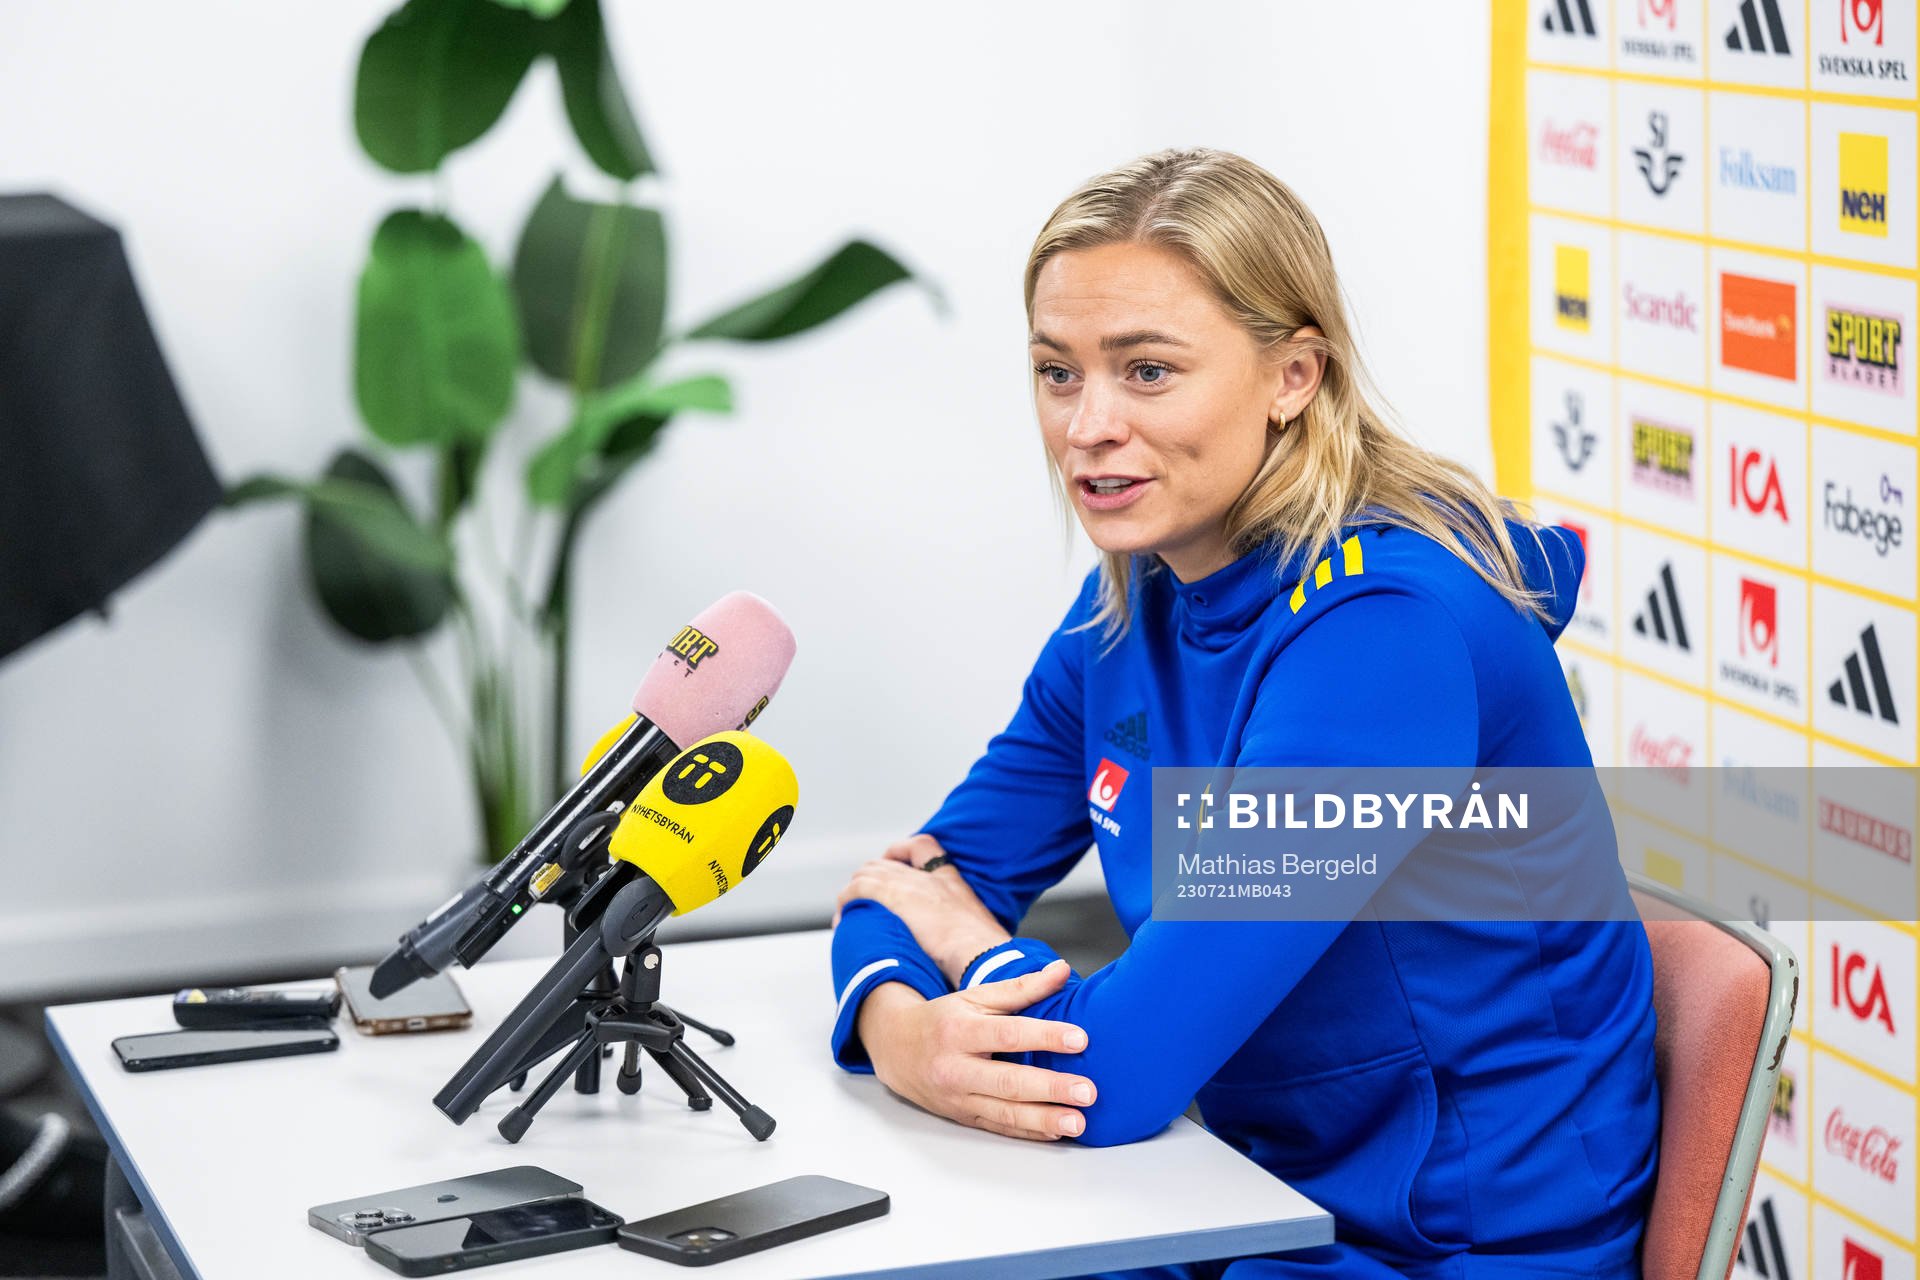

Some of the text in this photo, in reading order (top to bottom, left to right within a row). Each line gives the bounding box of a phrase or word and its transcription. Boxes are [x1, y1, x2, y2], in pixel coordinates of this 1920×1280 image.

[1818, 55, 1909, 81] SVENSKA SPEL
[1826, 308, 1901, 371] SPORT
[1730, 444, 1789, 523] ICA
[1825, 482, 1902, 556] Fabege
[631, 803, 695, 844] NYHETSBYRÅN
[1832, 943, 1896, 1036] ICA
